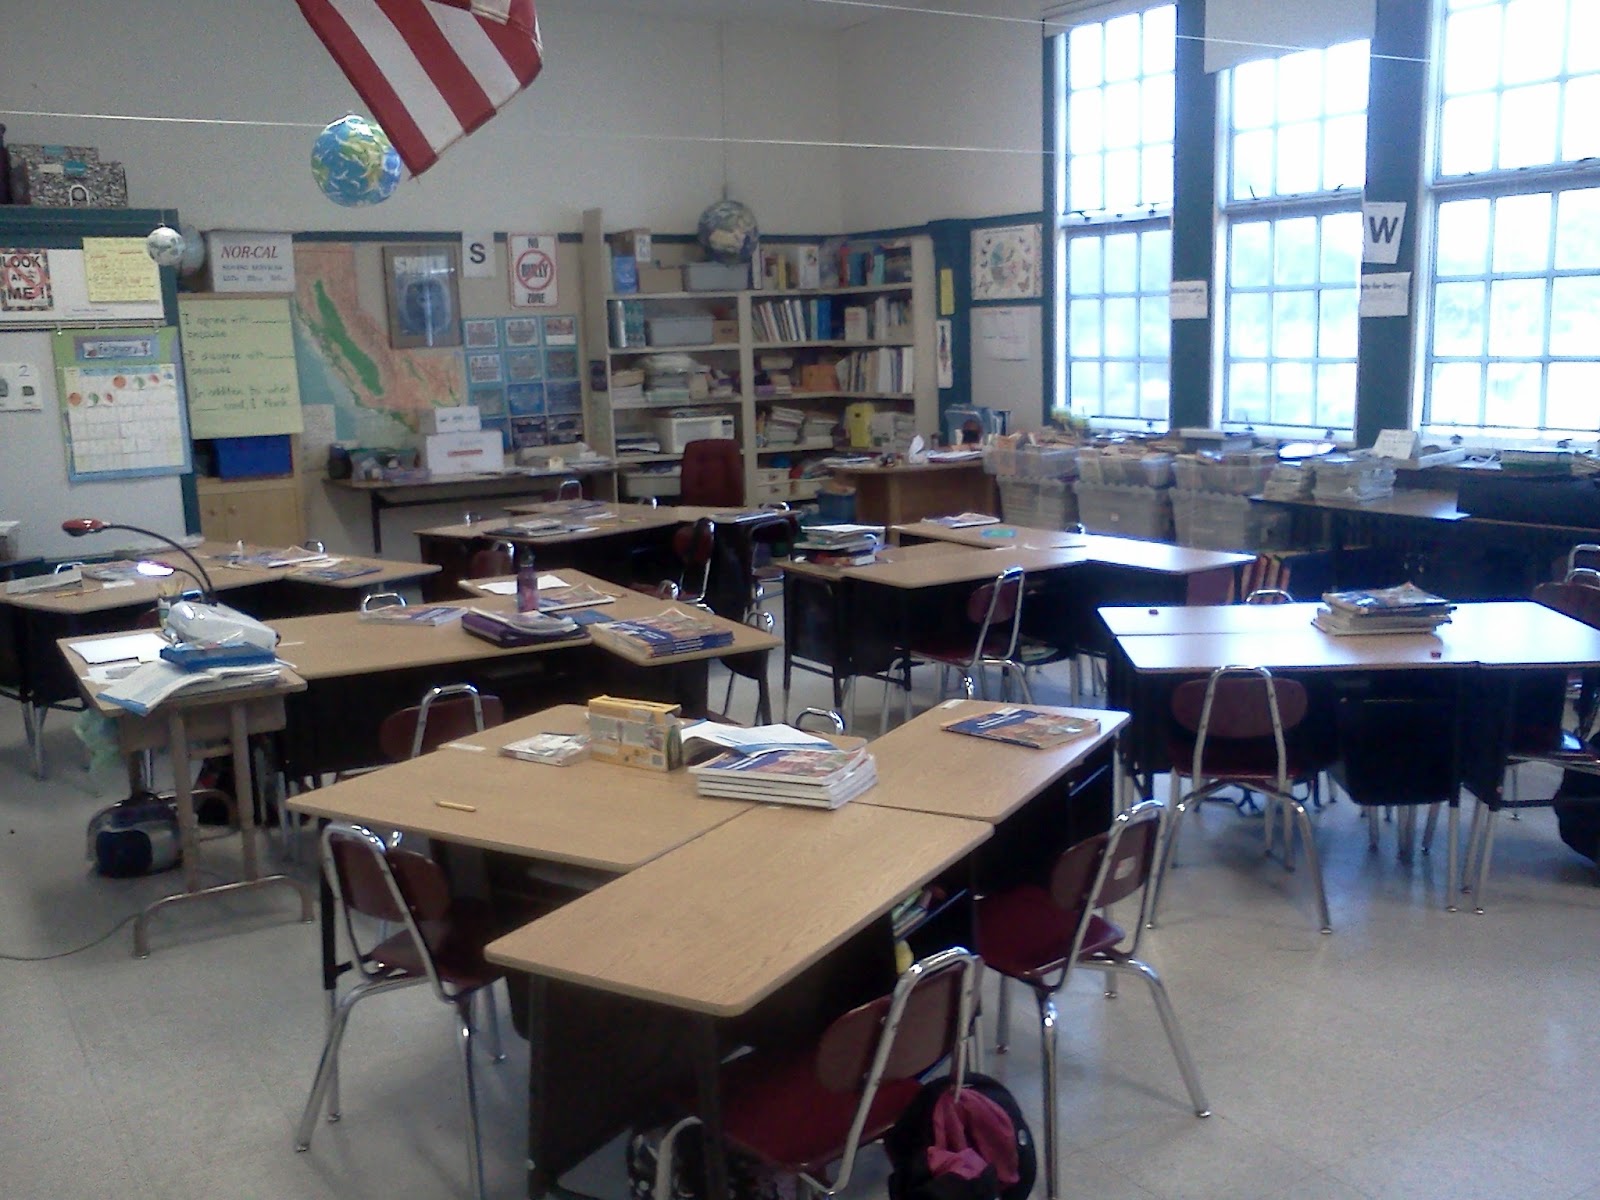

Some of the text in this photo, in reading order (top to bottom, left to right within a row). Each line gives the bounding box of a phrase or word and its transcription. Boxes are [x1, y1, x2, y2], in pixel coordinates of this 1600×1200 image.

[1369, 216, 1399, 243] W
[527, 237, 539, 249] NO
[221, 245, 279, 259] NOR-CAL
[469, 243, 486, 264] S
[3, 256, 41, 268] LOOK
[19, 365, 30, 377] 2
